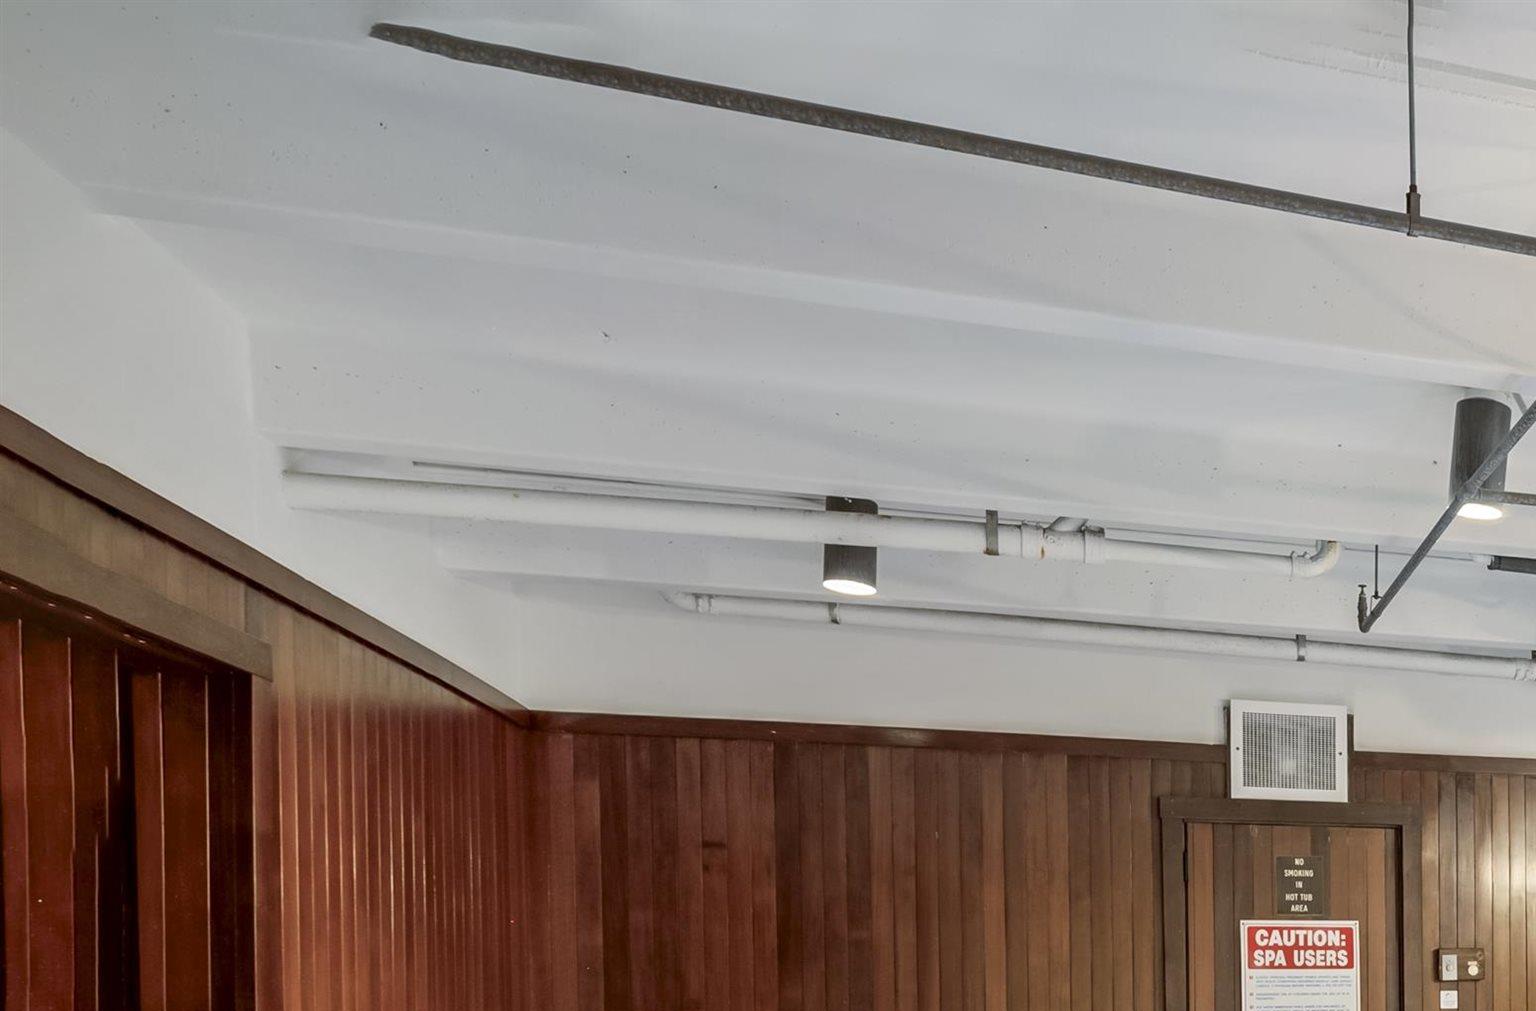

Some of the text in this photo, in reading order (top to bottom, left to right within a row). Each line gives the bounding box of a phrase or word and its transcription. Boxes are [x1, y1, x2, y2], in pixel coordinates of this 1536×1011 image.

[1294, 857, 1305, 866] NO
[1283, 869, 1314, 878] SMOKING
[1295, 880, 1303, 889] IN
[1285, 893, 1313, 902] HOT TUB
[1290, 904, 1309, 912] AREA
[1254, 928, 1347, 947] CAUTION:
[1253, 949, 1349, 967] SPA USERS
